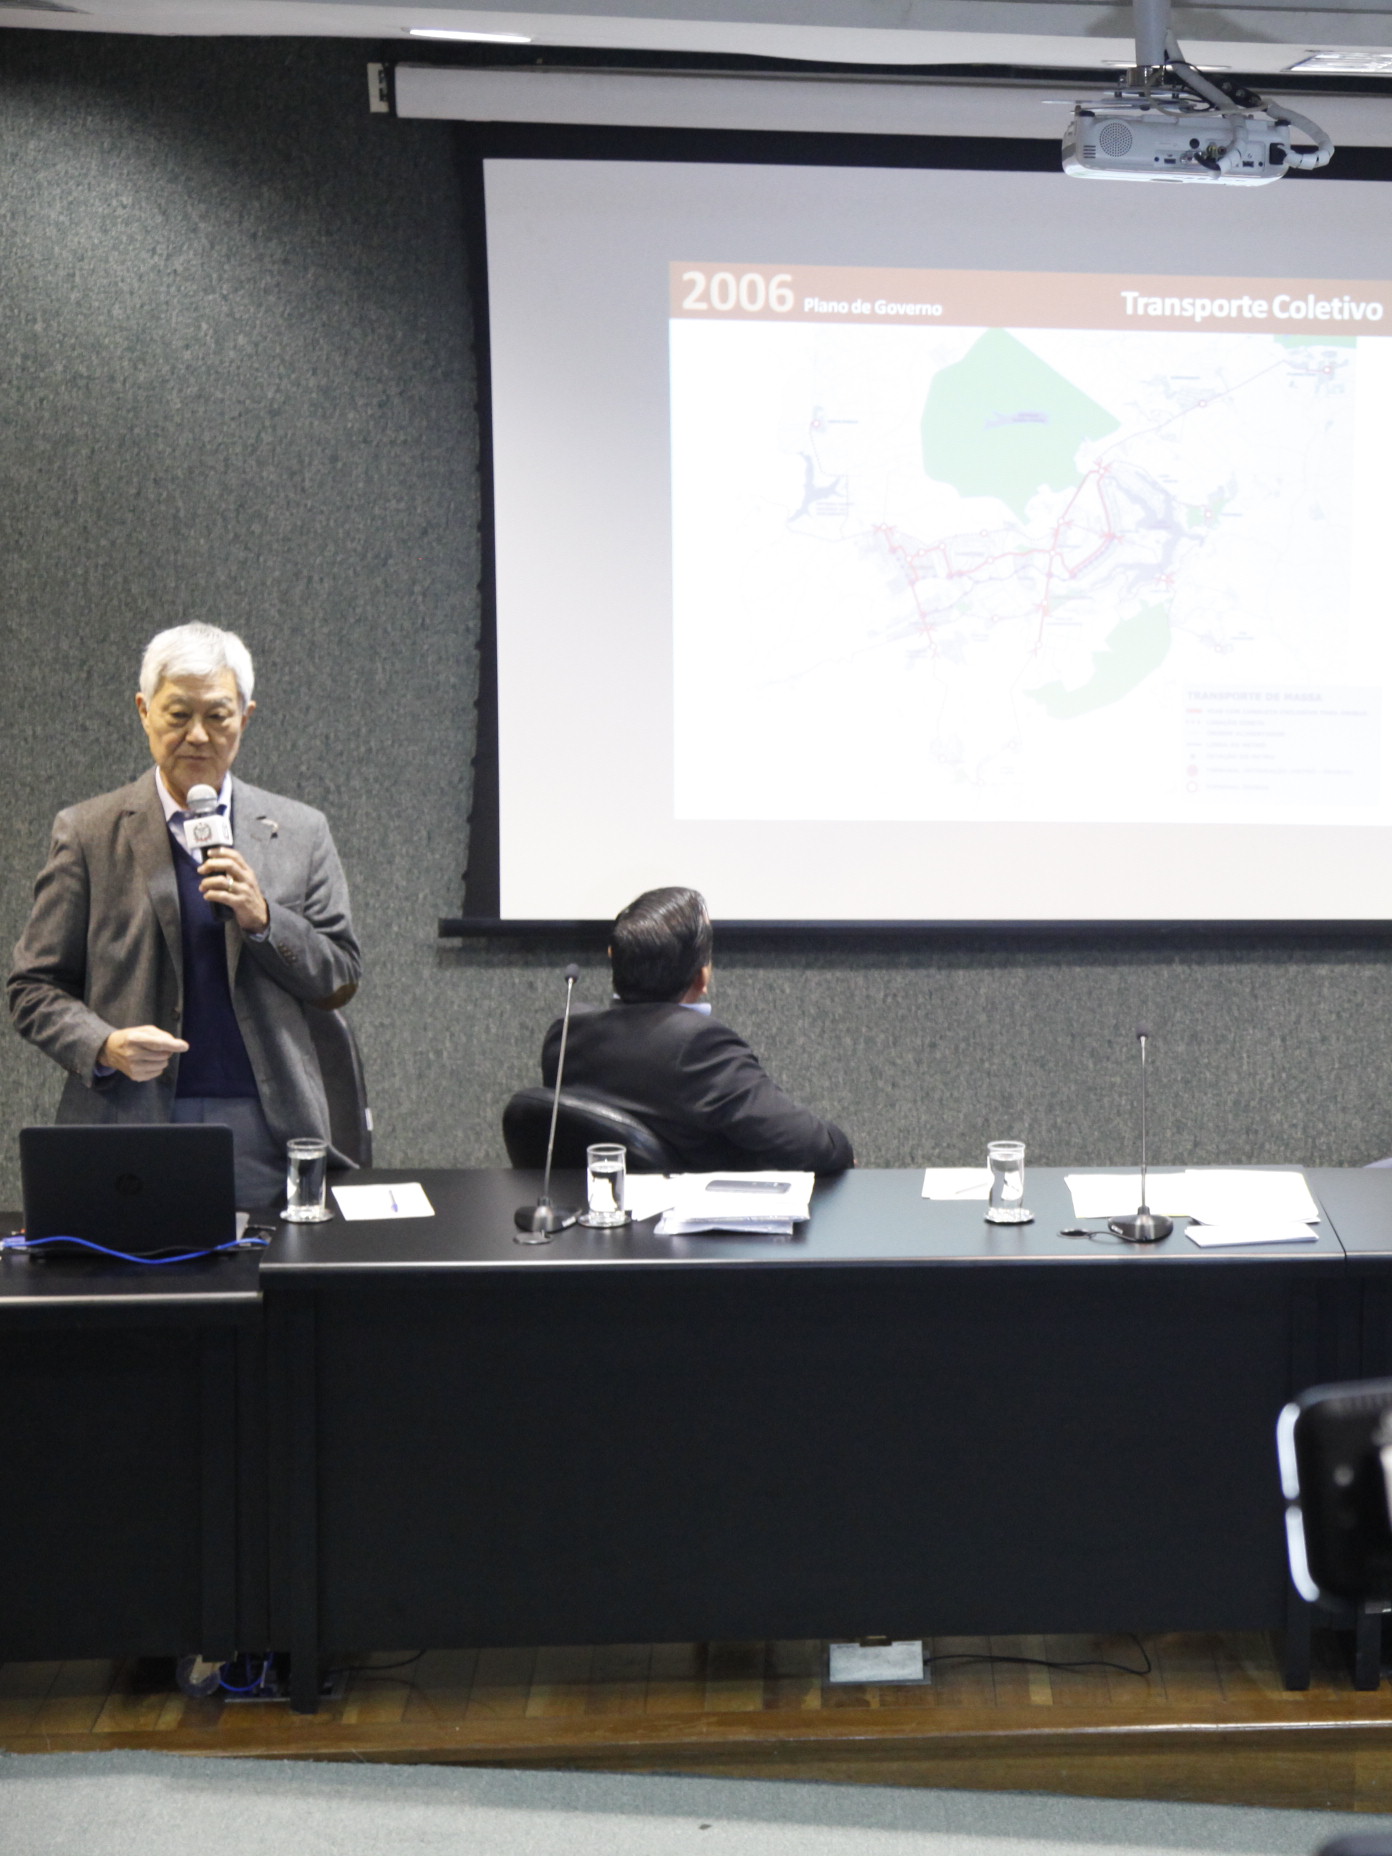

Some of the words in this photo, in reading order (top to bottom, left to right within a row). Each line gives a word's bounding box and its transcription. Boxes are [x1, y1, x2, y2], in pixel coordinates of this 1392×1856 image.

[681, 271, 795, 312] 2006
[803, 298, 849, 313] Plano
[851, 299, 871, 313] de
[874, 299, 943, 316] Governo
[1122, 291, 1268, 322] Transporte
[1272, 294, 1384, 321] Coletivo
